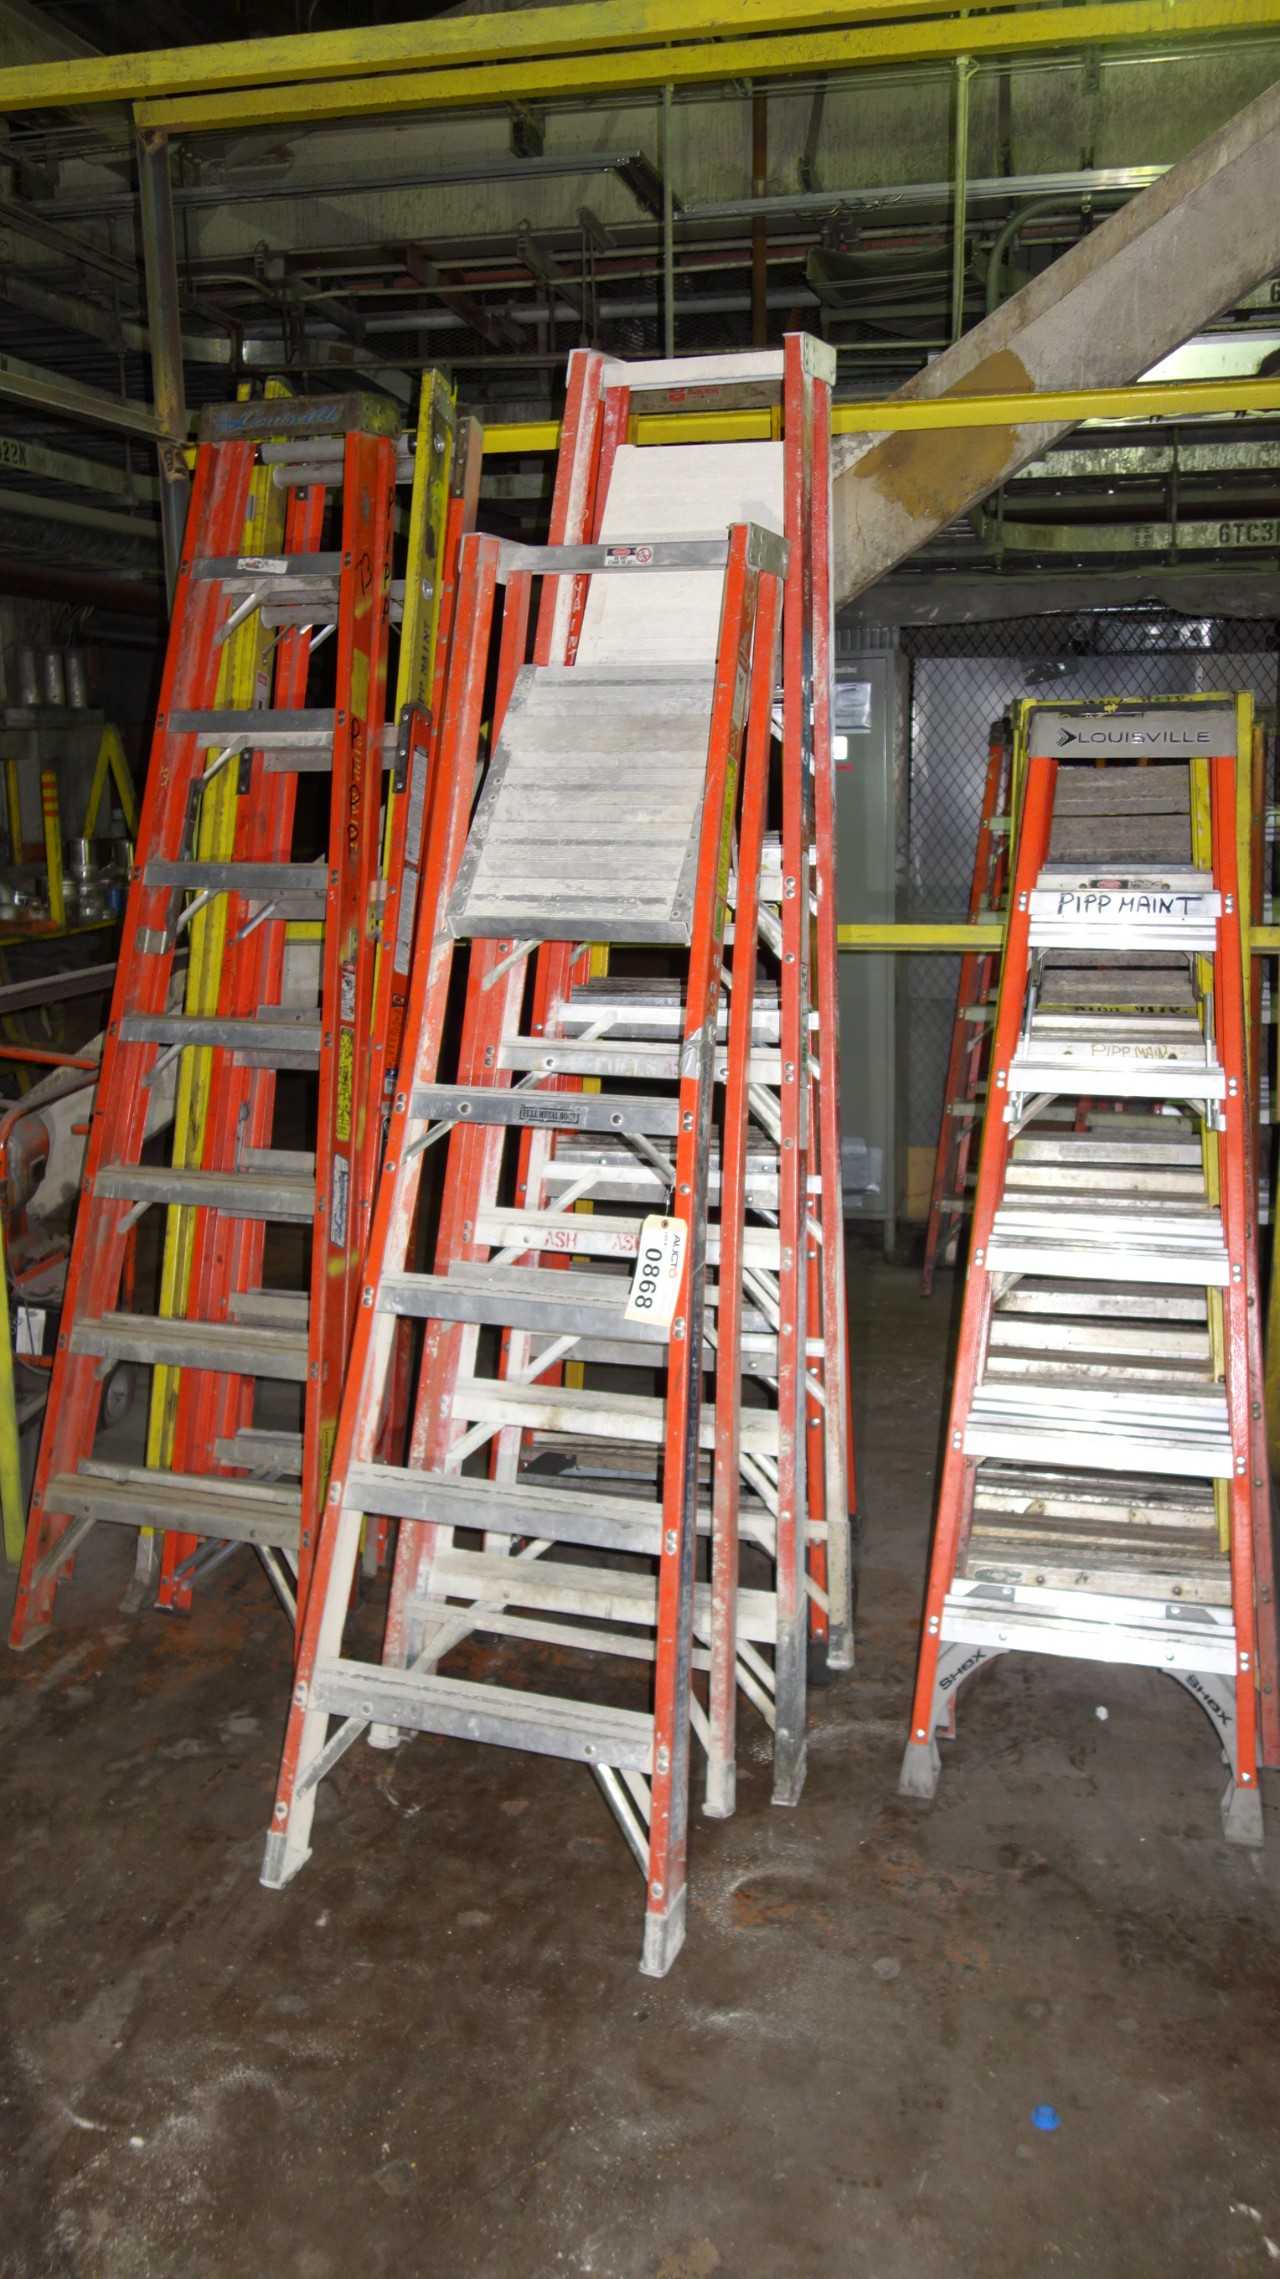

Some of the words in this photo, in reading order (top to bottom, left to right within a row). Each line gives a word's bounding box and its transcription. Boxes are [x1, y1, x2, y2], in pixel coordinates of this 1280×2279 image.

[1218, 521, 1280, 544] 6TC3
[1077, 729, 1211, 745] LOUISVILLE
[1057, 892, 1111, 915] PIPP
[1118, 896, 1203, 916] MAINT
[543, 1231, 578, 1249] ASH
[634, 1247, 663, 1309] 0868
